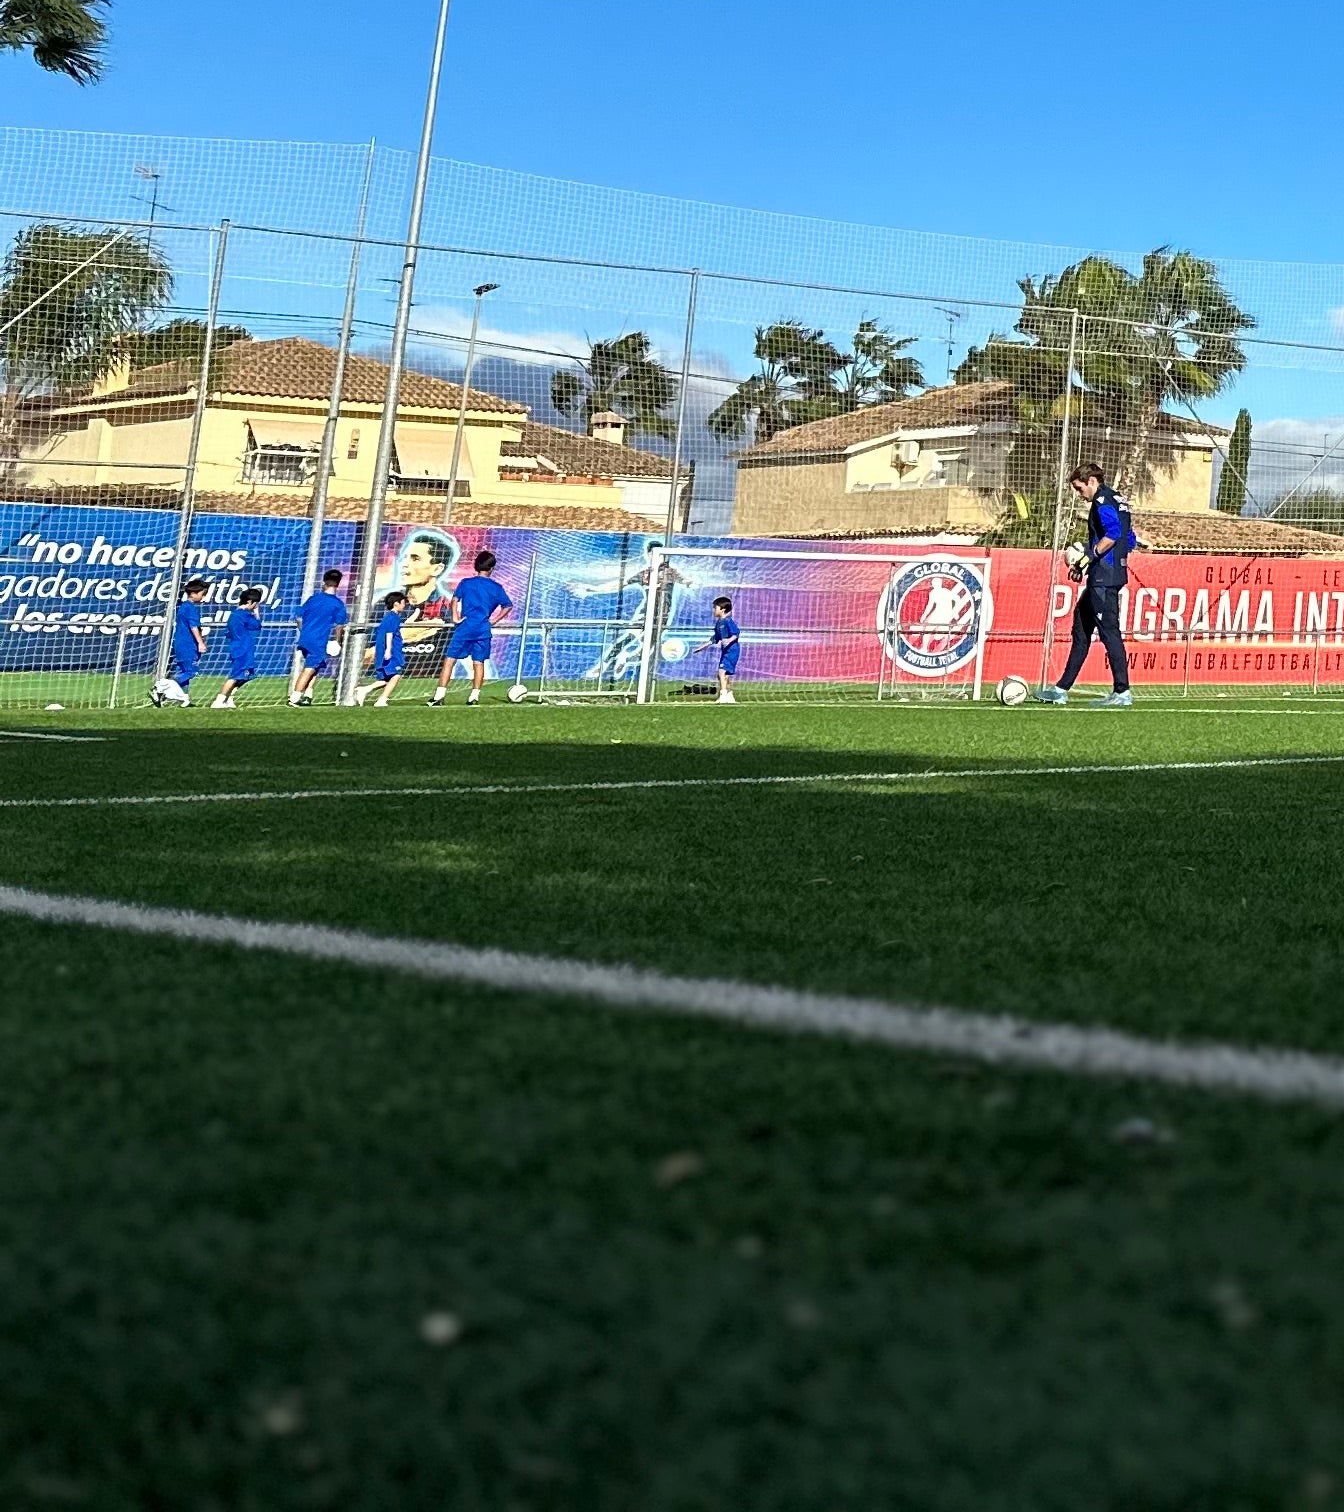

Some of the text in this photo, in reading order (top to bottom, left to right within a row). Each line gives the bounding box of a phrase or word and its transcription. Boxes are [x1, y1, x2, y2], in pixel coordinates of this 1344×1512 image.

[86, 536, 248, 571] hacemos
[914, 562, 965, 580] GLOBAL
[1206, 566, 1274, 585] GLOBAL
[135, 572, 174, 602] de
[181, 573, 282, 610] útbol,
[10, 603, 232, 637] los creams"
[1053, 584, 1274, 644] PGRAMA
